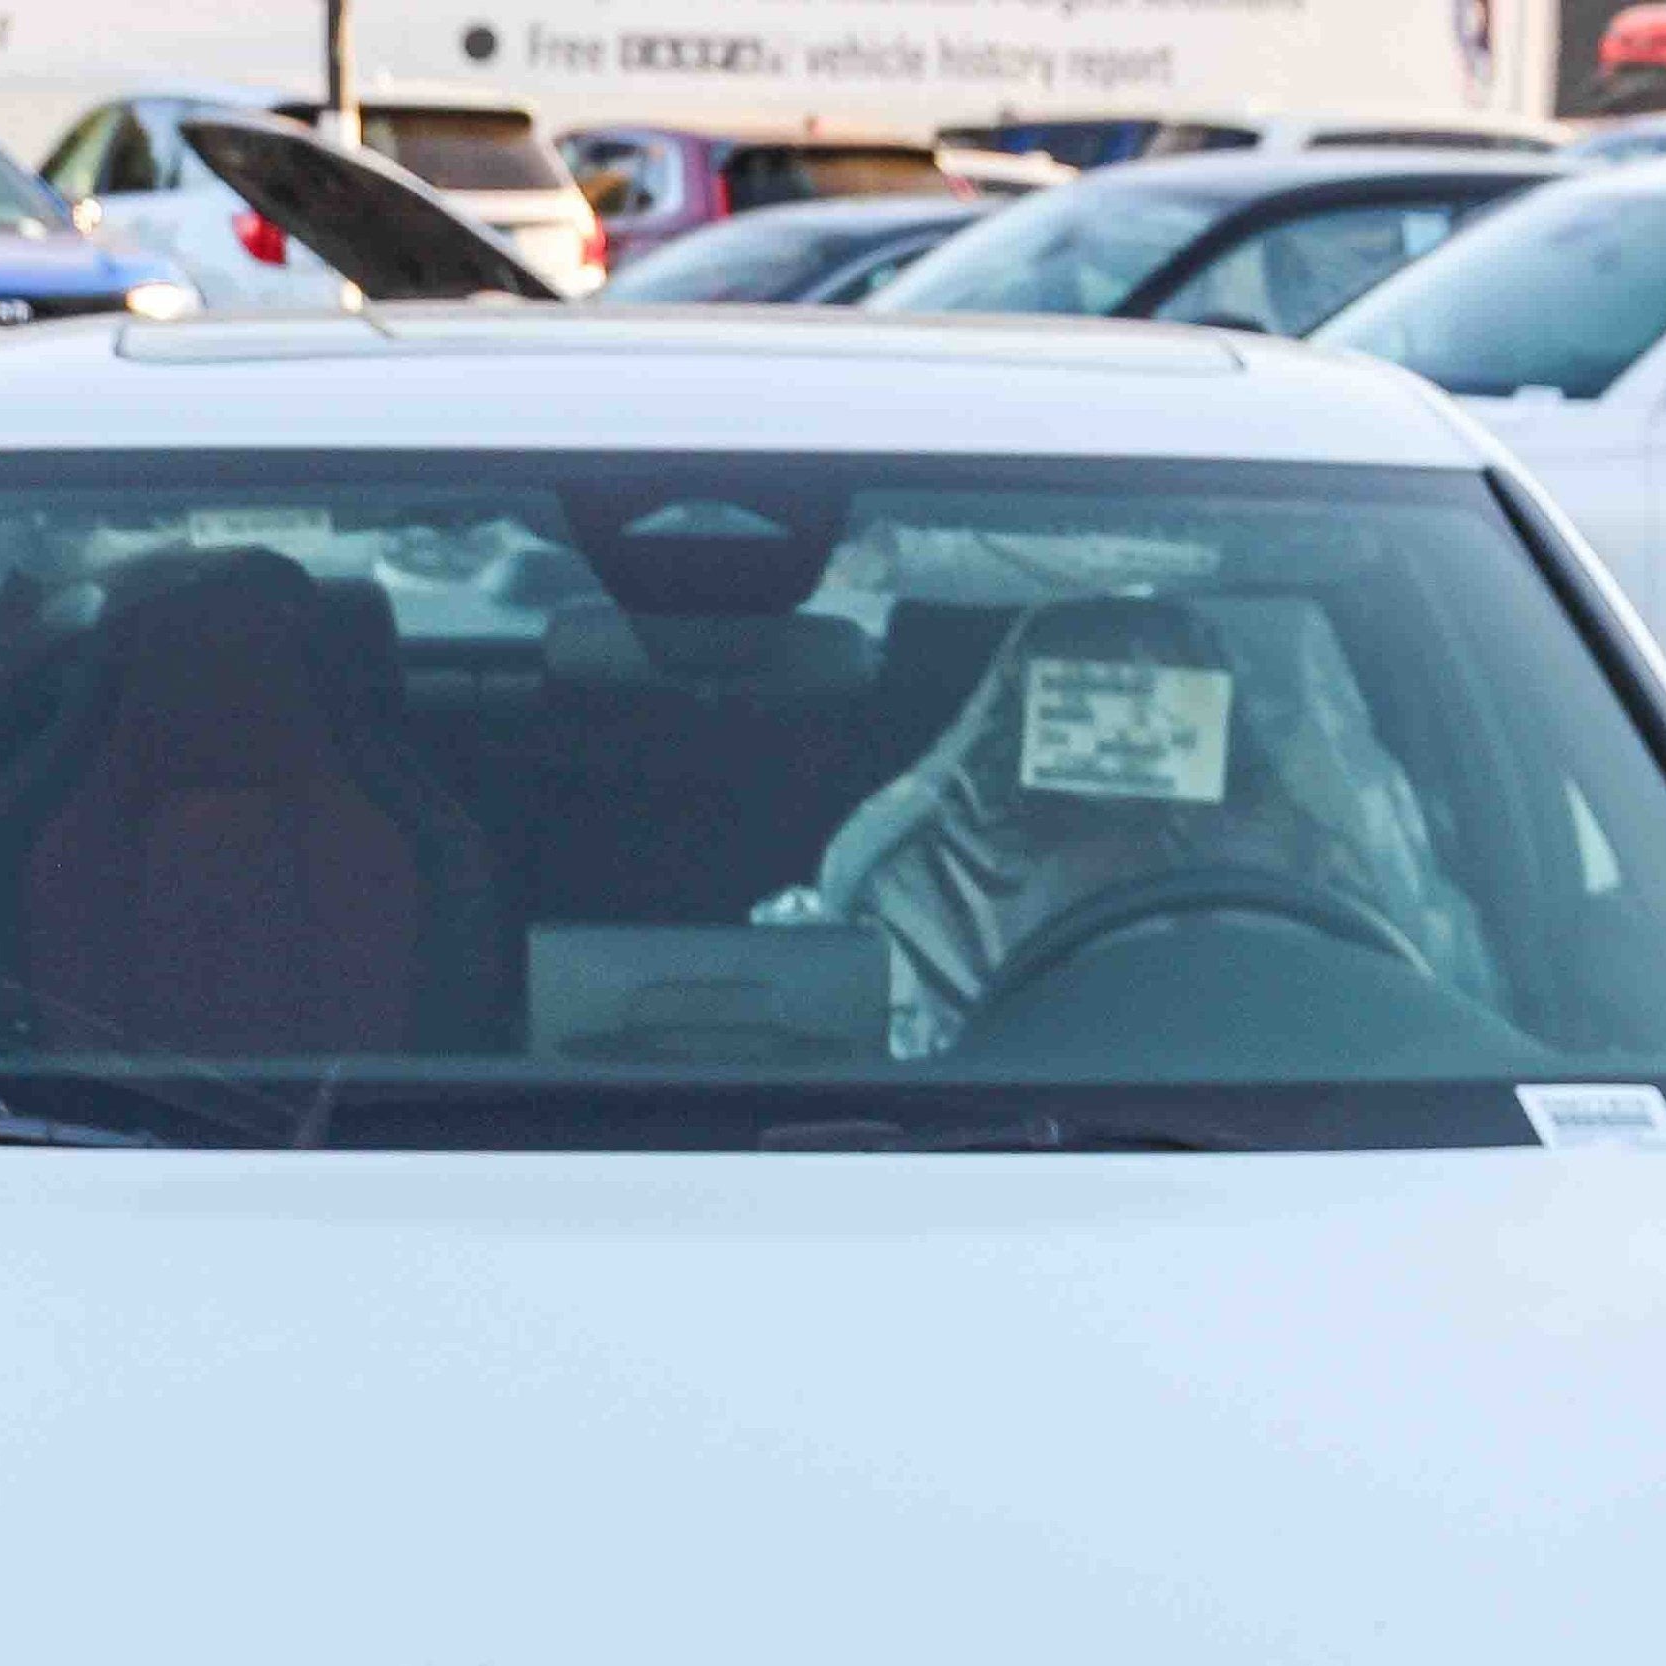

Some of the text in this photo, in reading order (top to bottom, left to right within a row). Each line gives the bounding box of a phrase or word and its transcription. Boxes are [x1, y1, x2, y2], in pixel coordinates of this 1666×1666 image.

[527, 23, 605, 68] Free
[805, 32, 926, 78] vehicle
[936, 36, 1055, 88] history
[1066, 42, 1174, 88] report
